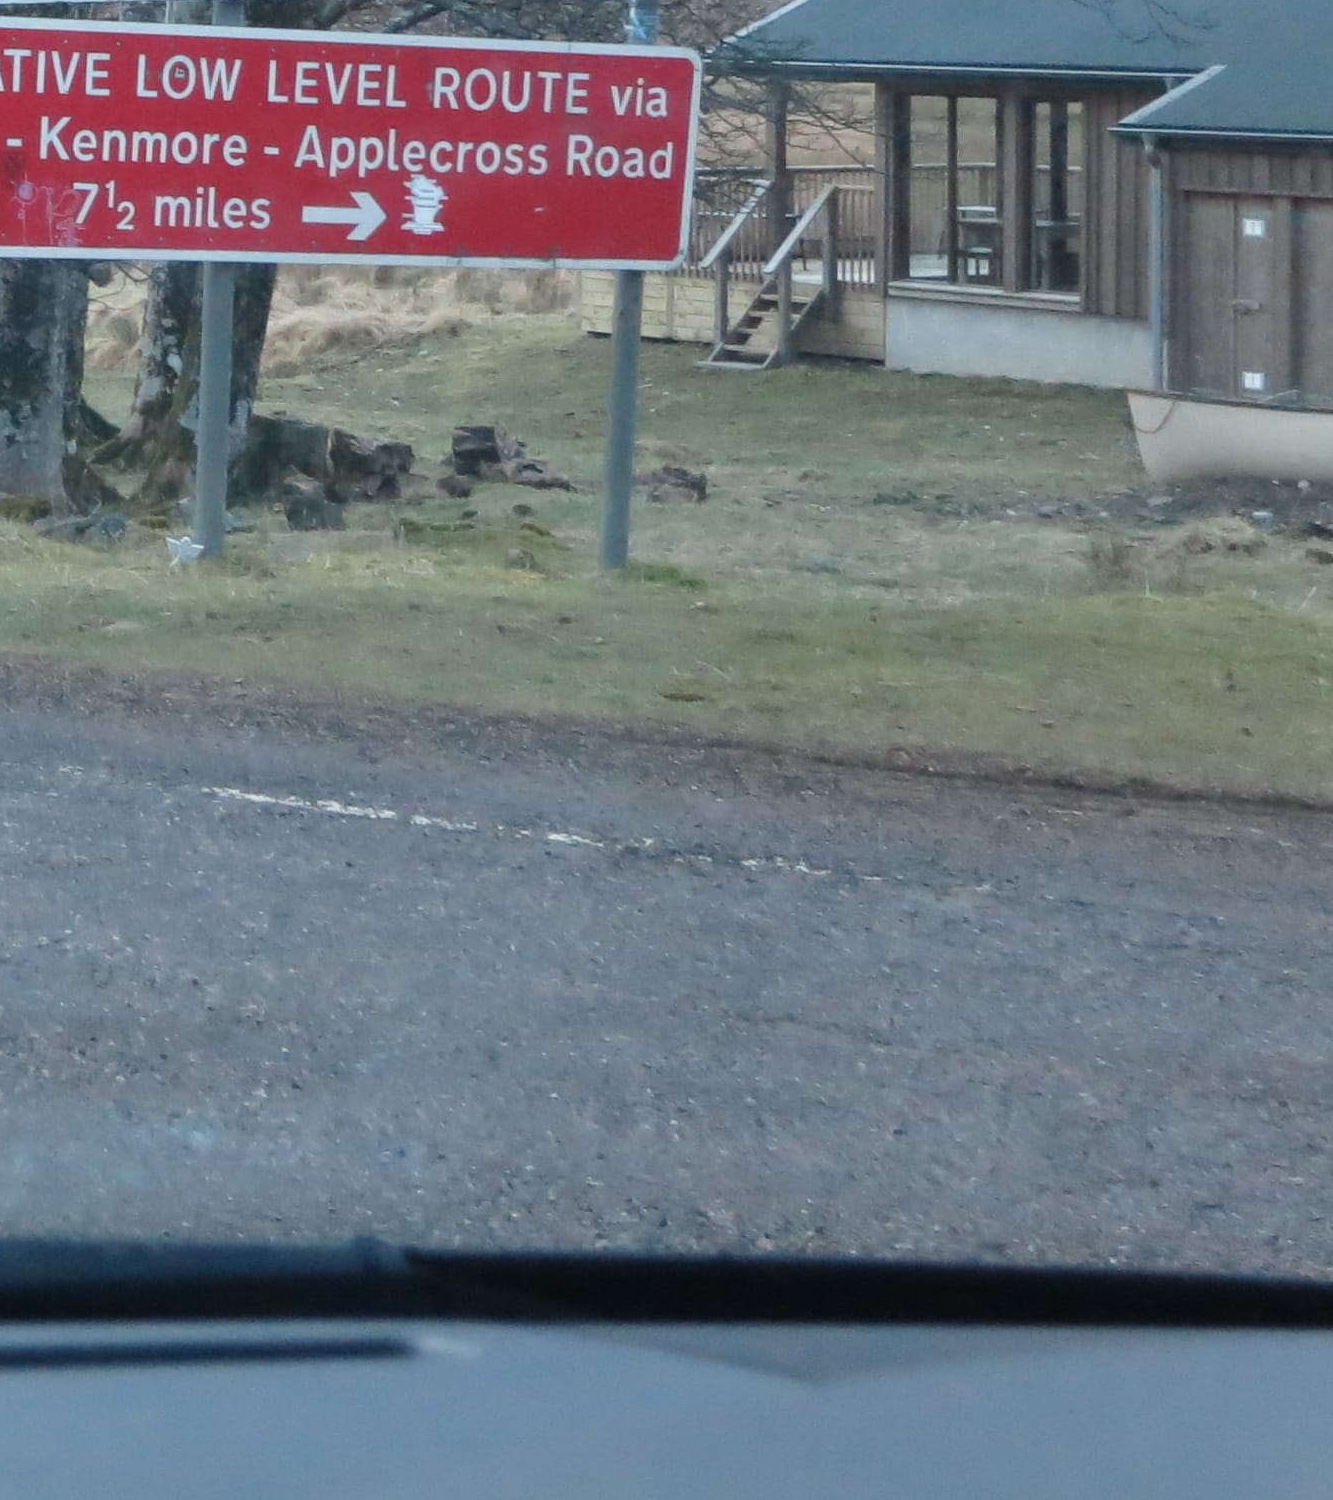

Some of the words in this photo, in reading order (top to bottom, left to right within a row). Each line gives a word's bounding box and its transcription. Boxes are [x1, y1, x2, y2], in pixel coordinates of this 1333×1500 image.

[136, 54, 243, 101] LOW
[266, 59, 407, 108] LEVEL
[432, 66, 591, 114] ROUTE
[610, 77, 669, 117] via
[38, 115, 248, 166] Kenmore
[293, 124, 549, 178] Applecross
[566, 133, 675, 180] Road
[153, 186, 272, 229] miles
